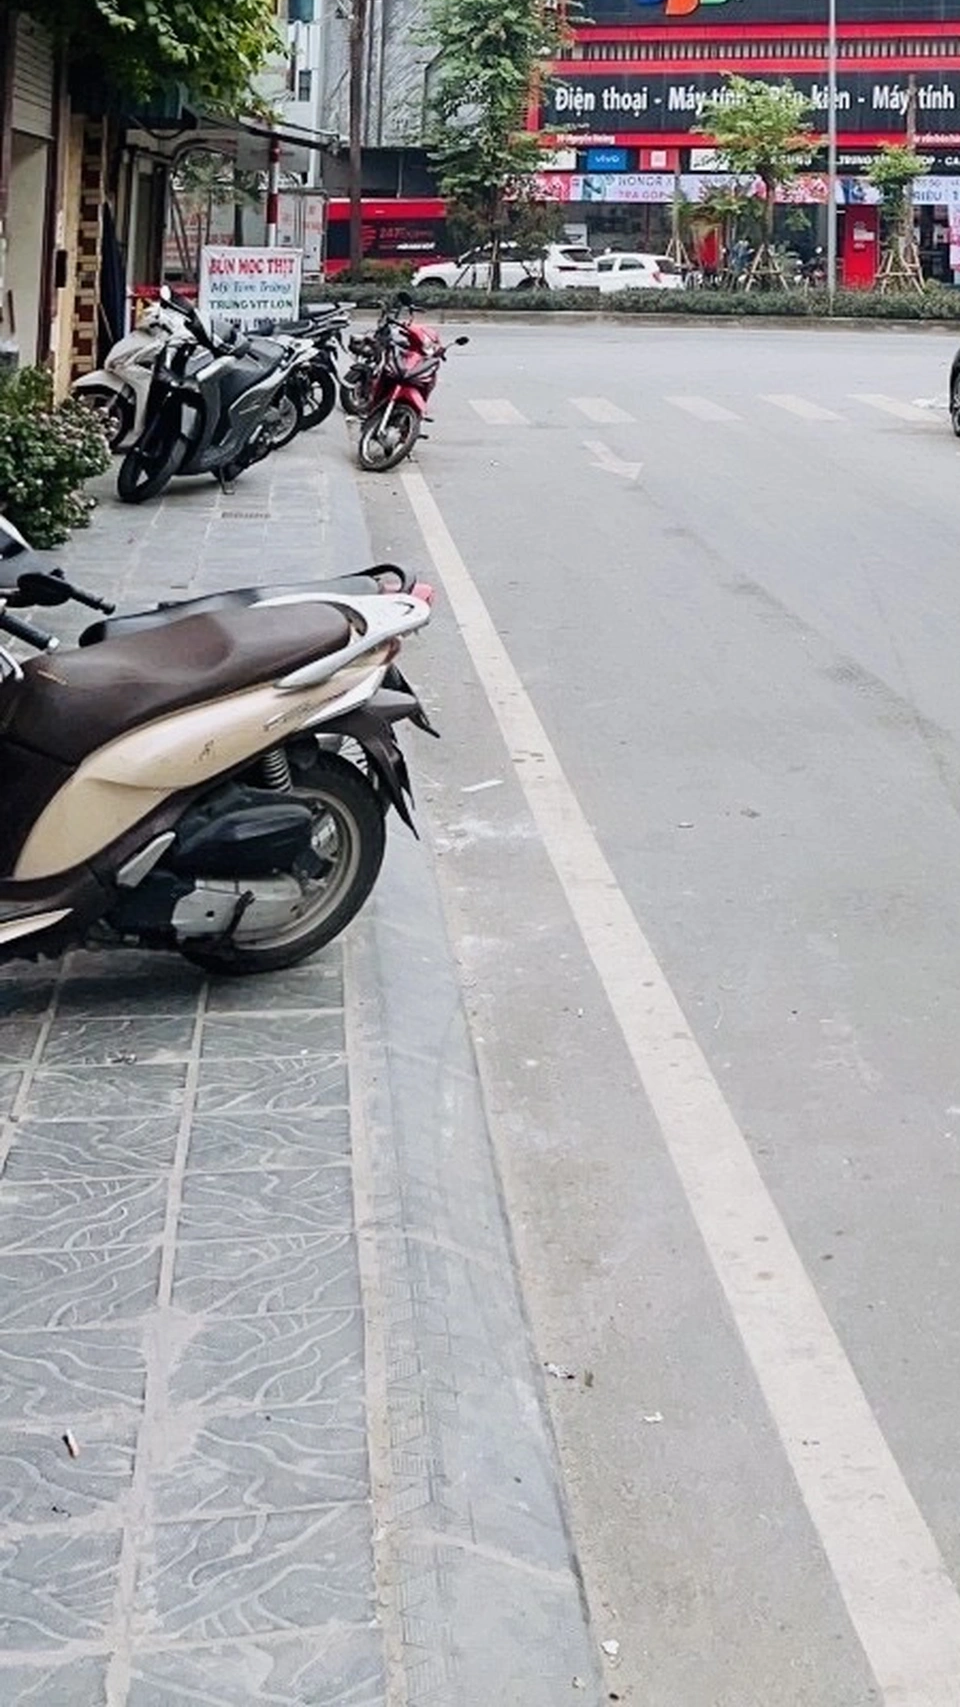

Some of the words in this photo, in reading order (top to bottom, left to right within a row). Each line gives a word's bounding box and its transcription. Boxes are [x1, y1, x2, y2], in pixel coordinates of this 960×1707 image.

[555, 86, 595, 117] Điện
[602, 84, 648, 117] thoại
[668, 84, 704, 115] Máy
[872, 84, 910, 115] Máy
[918, 83, 955, 110] tính
[595, 155, 619, 163] vivo
